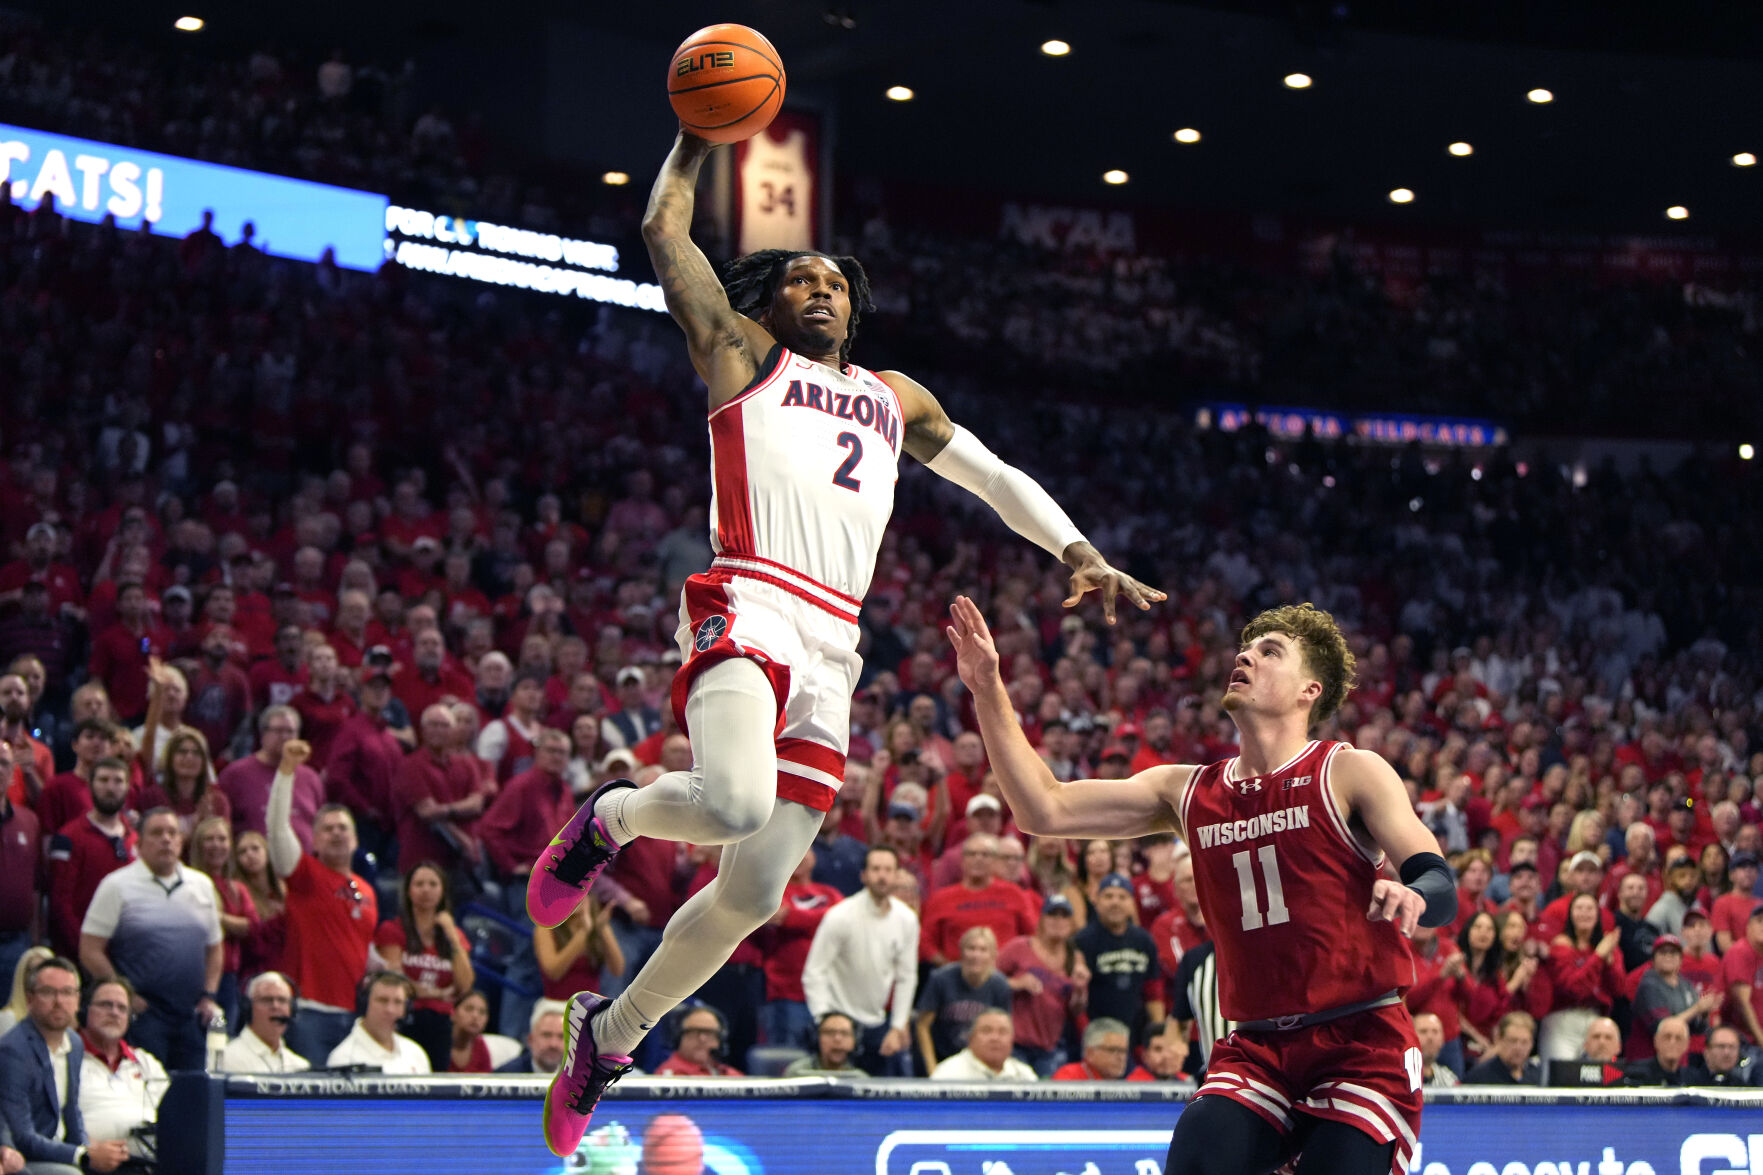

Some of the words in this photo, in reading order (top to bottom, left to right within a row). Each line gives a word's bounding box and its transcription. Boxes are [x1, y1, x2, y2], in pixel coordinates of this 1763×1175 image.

[677, 51, 735, 77] ELITE
[760, 181, 796, 219] 34
[781, 379, 898, 458] ARIZONA
[832, 431, 864, 493] 2
[1197, 805, 1310, 850] WISCONSIN
[1232, 845, 1290, 932] 11
[563, 999, 588, 1078] NIKE
